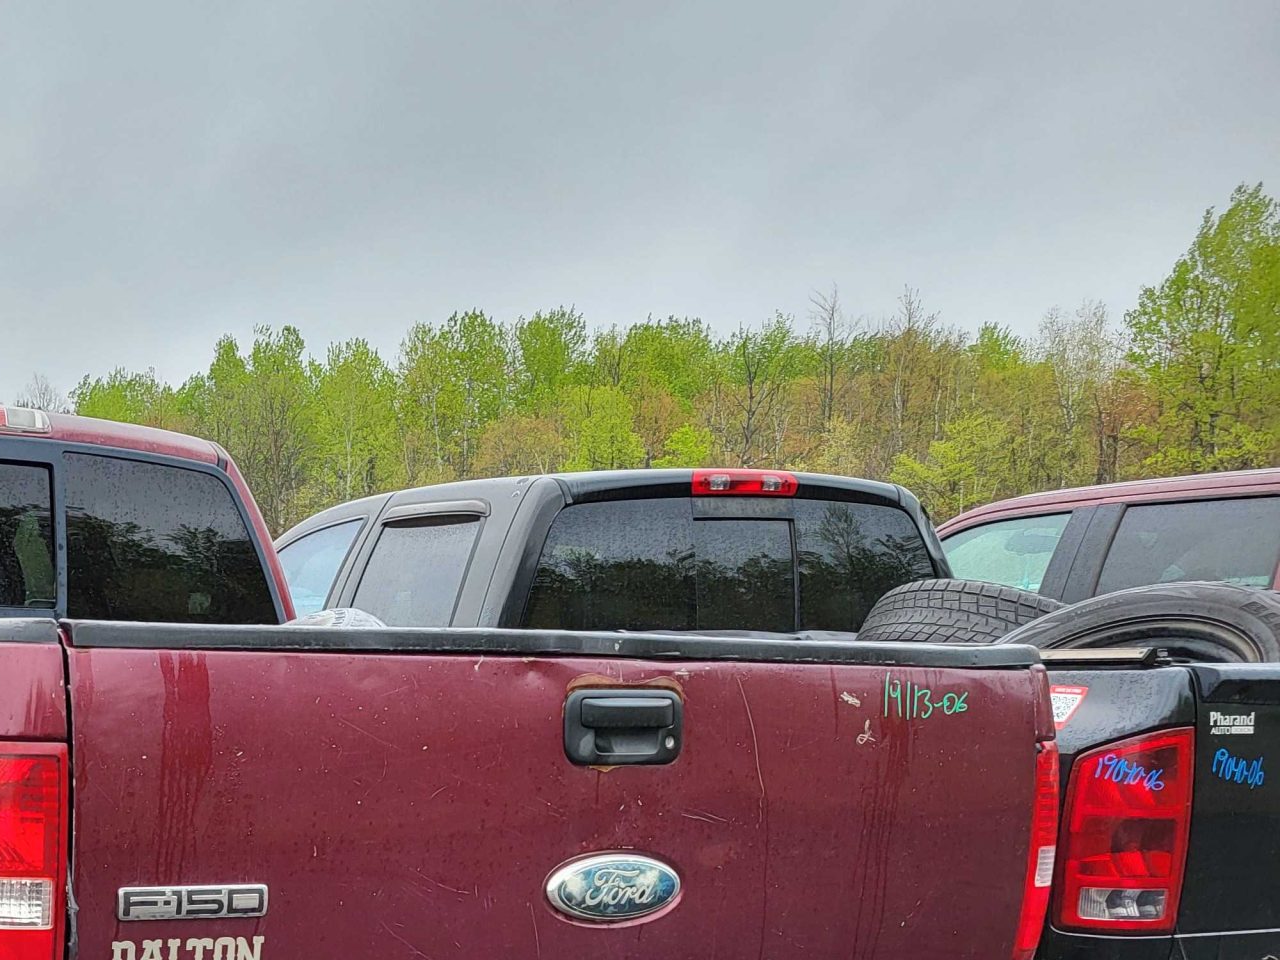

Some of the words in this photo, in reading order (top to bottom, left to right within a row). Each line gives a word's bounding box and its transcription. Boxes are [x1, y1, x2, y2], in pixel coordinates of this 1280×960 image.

[884, 671, 969, 721] 19113-06
[1209, 711, 1256, 726] Pharand
[1210, 726, 1231, 735] AUTO
[580, 868, 655, 907] Ford
